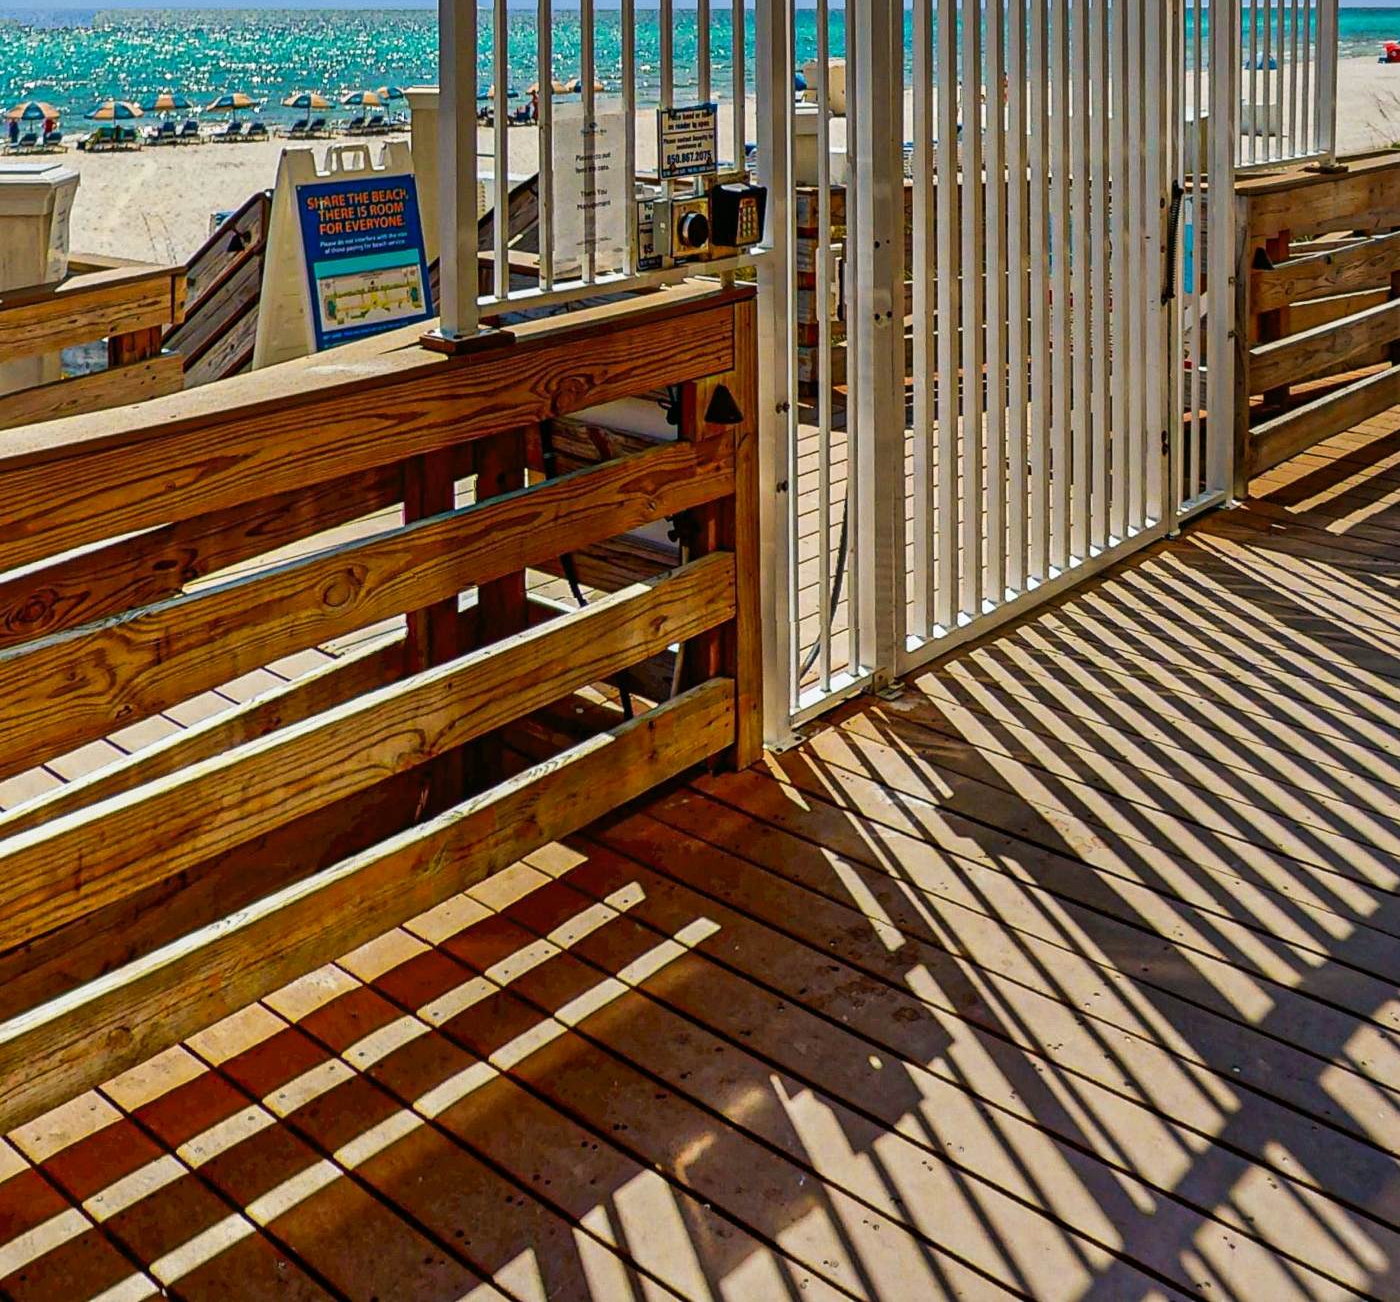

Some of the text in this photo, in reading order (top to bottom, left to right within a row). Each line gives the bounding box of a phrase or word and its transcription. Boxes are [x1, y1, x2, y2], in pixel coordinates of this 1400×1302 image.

[307, 194, 346, 210] SHARE
[347, 192, 369, 205] THE
[318, 202, 405, 222] THERE IS ROOM
[319, 215, 406, 235] FOR EVERYONE.
[320, 240, 336, 248] Please
